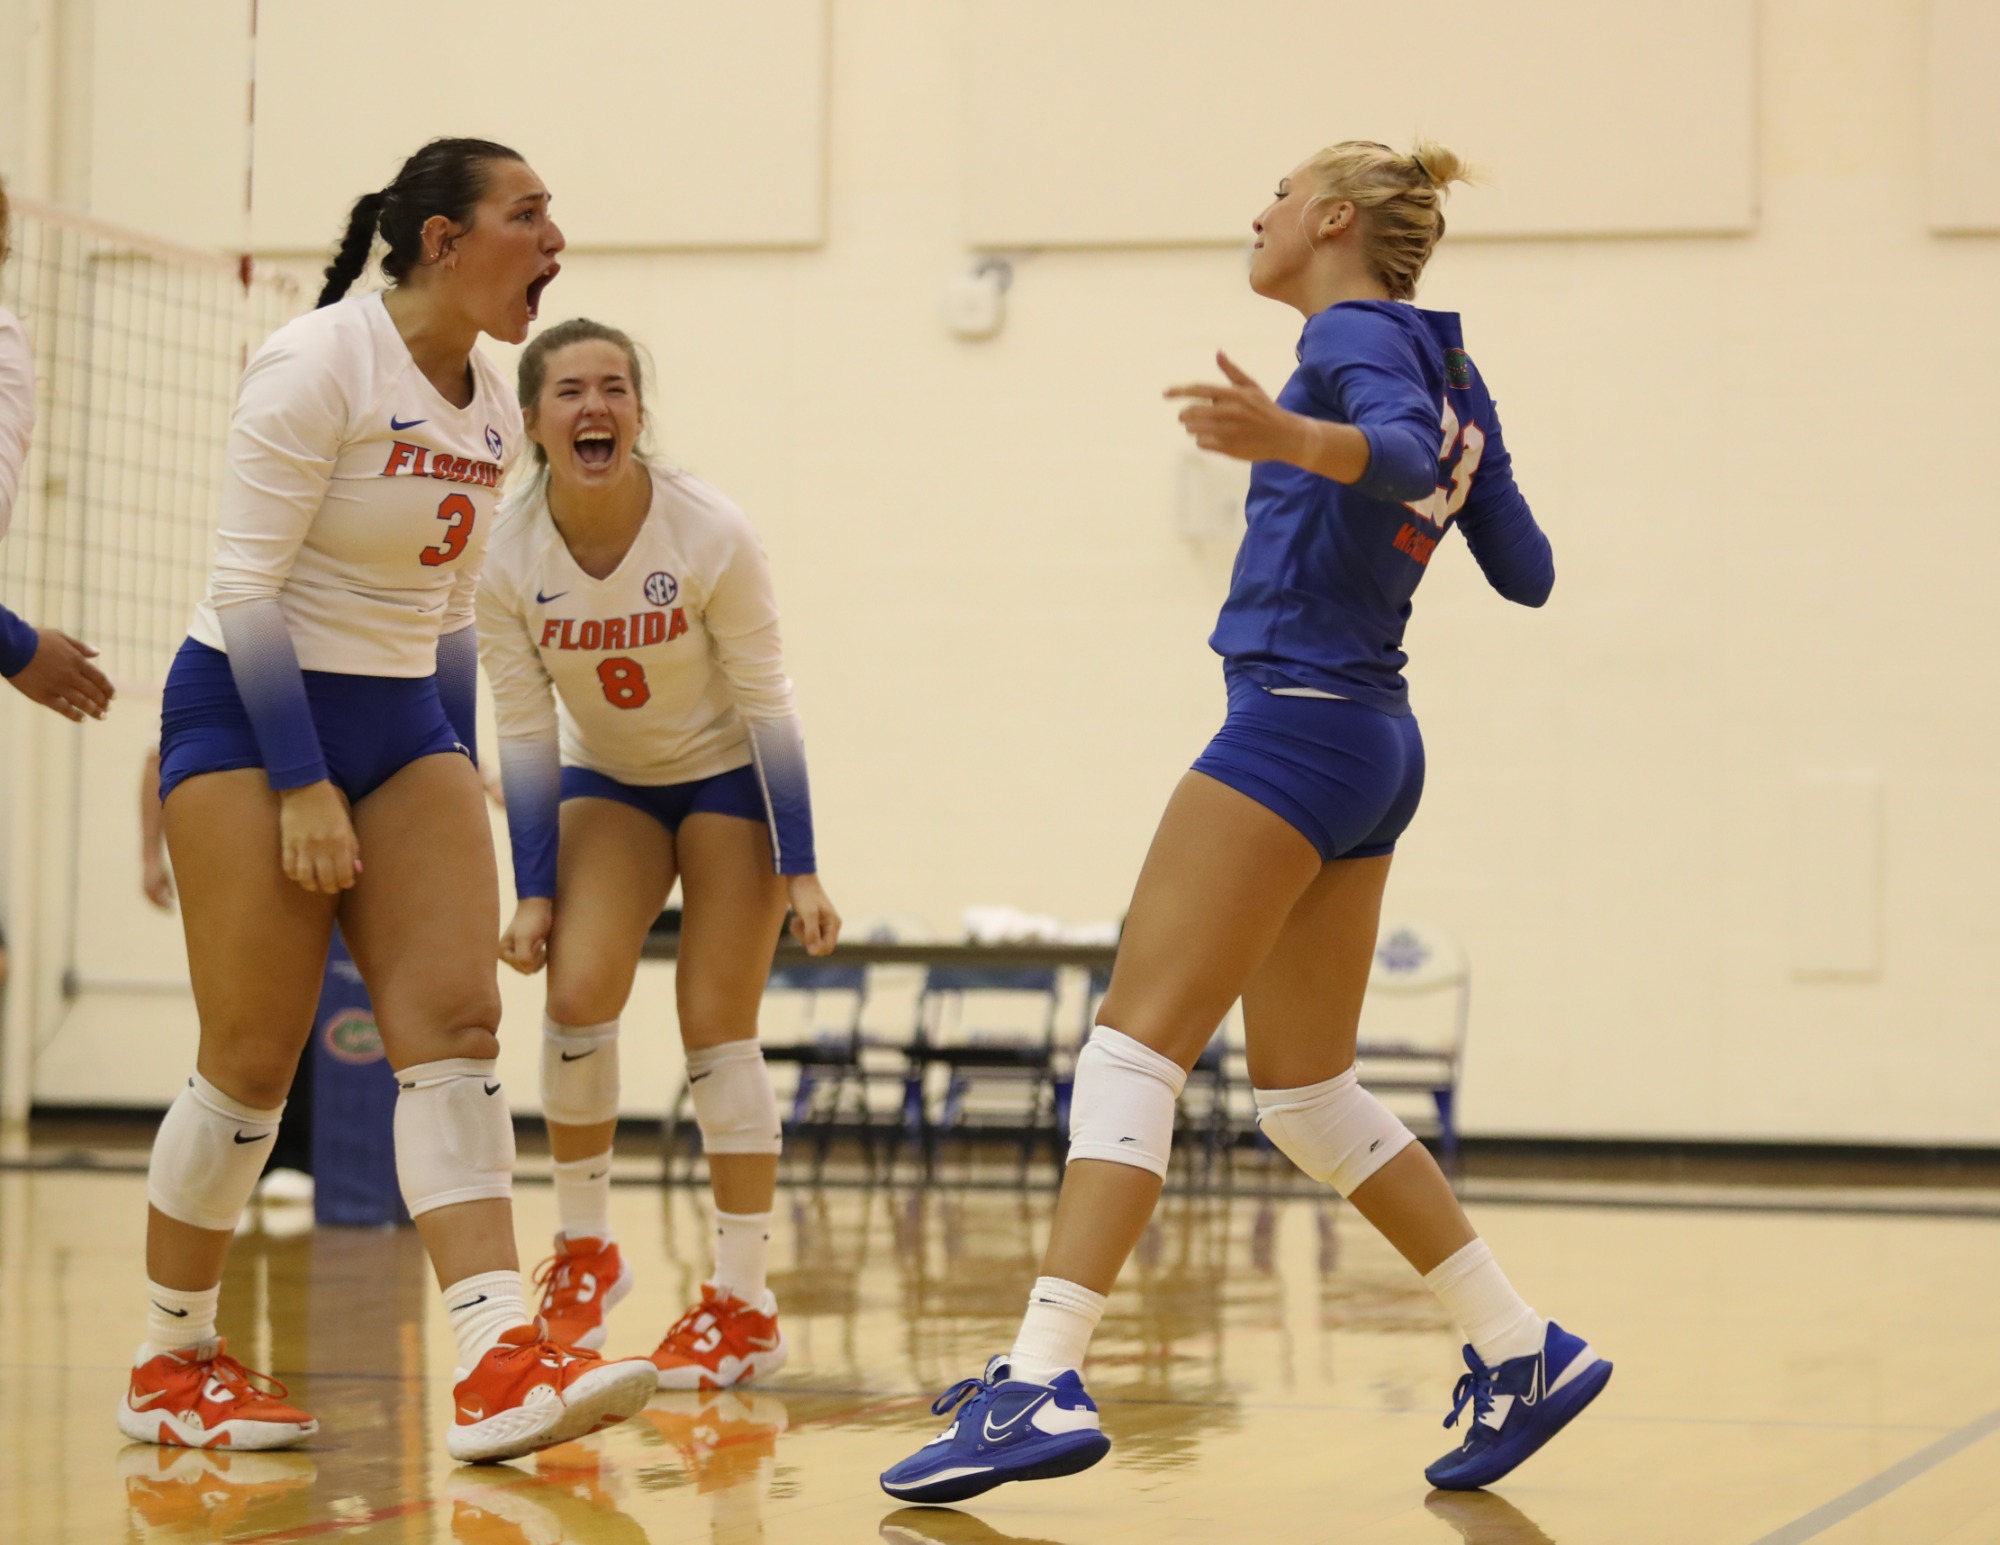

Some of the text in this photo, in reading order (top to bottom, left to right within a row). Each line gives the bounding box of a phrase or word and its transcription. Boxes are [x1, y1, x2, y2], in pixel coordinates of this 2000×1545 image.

[379, 440, 504, 488] FLORID
[419, 493, 475, 566] 3
[646, 573, 676, 604] SEC
[539, 607, 689, 651] FLORIDA
[596, 656, 651, 710] 8
